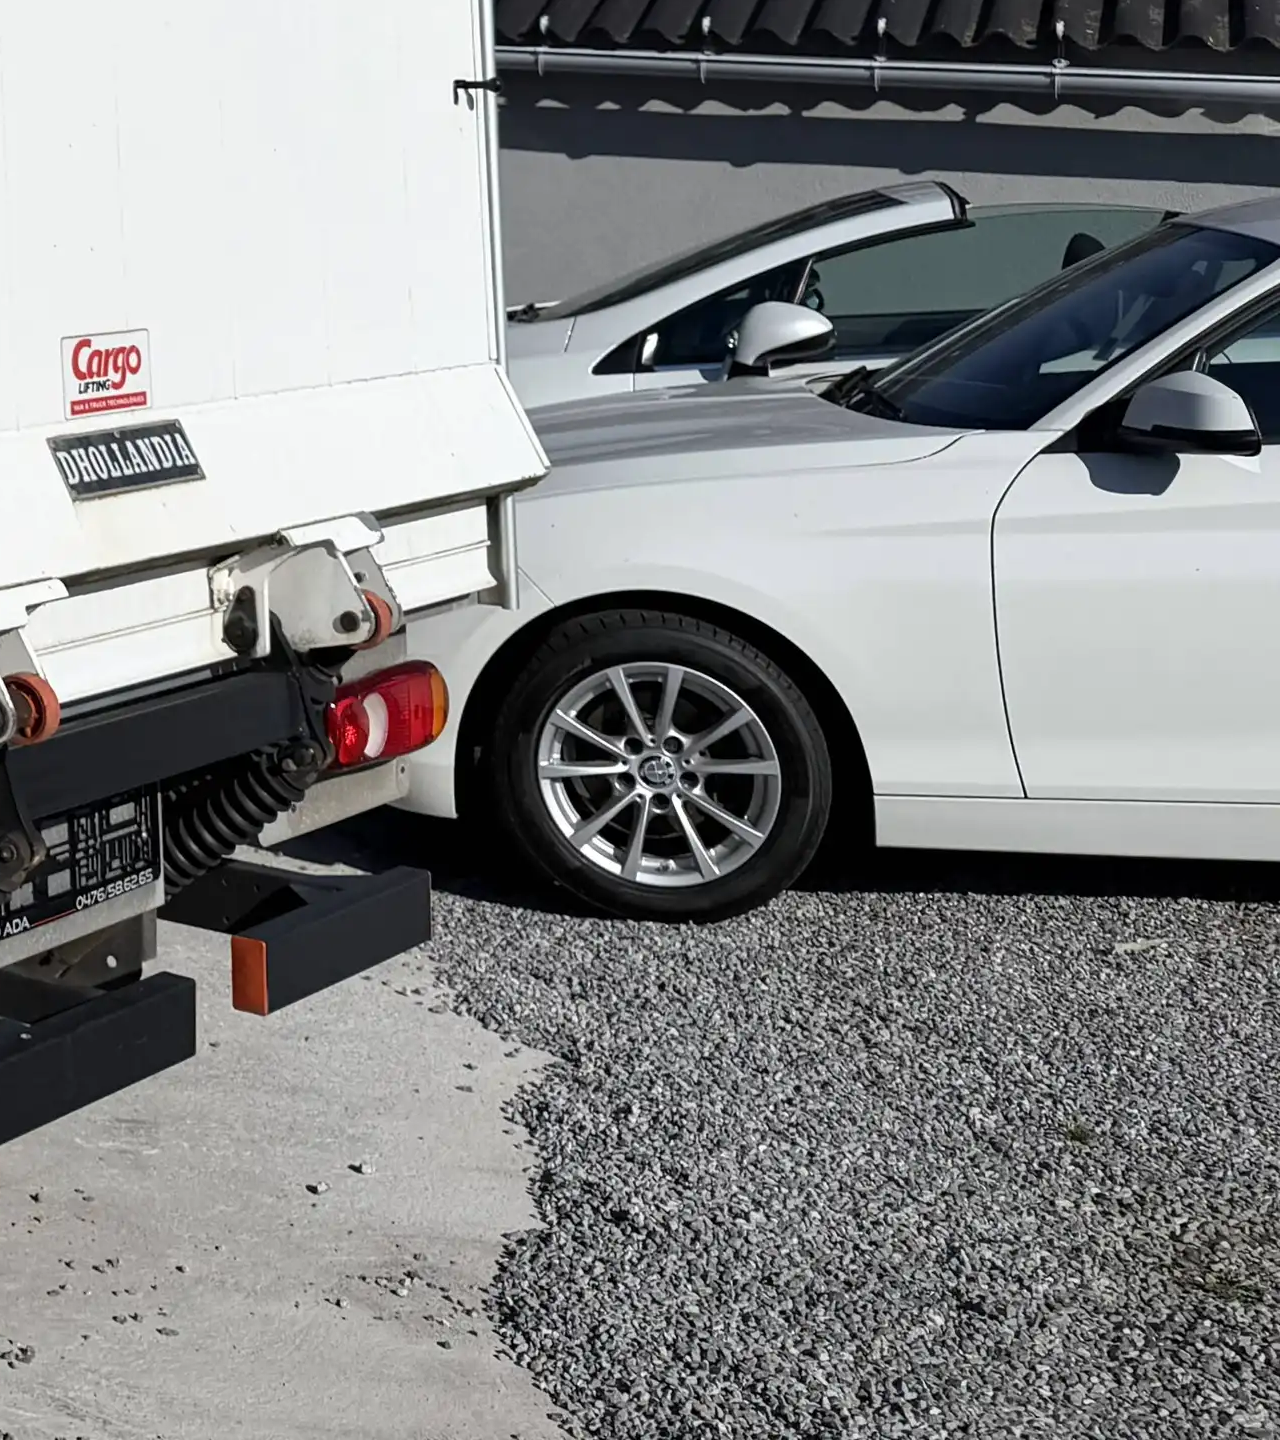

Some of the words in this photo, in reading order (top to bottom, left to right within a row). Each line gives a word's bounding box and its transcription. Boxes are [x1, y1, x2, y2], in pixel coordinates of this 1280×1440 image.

[71, 338, 142, 390] Cargo
[78, 379, 111, 395] LIFTING
[56, 432, 197, 485] DHOLLANDIA
[3, 915, 31, 937] ADA
